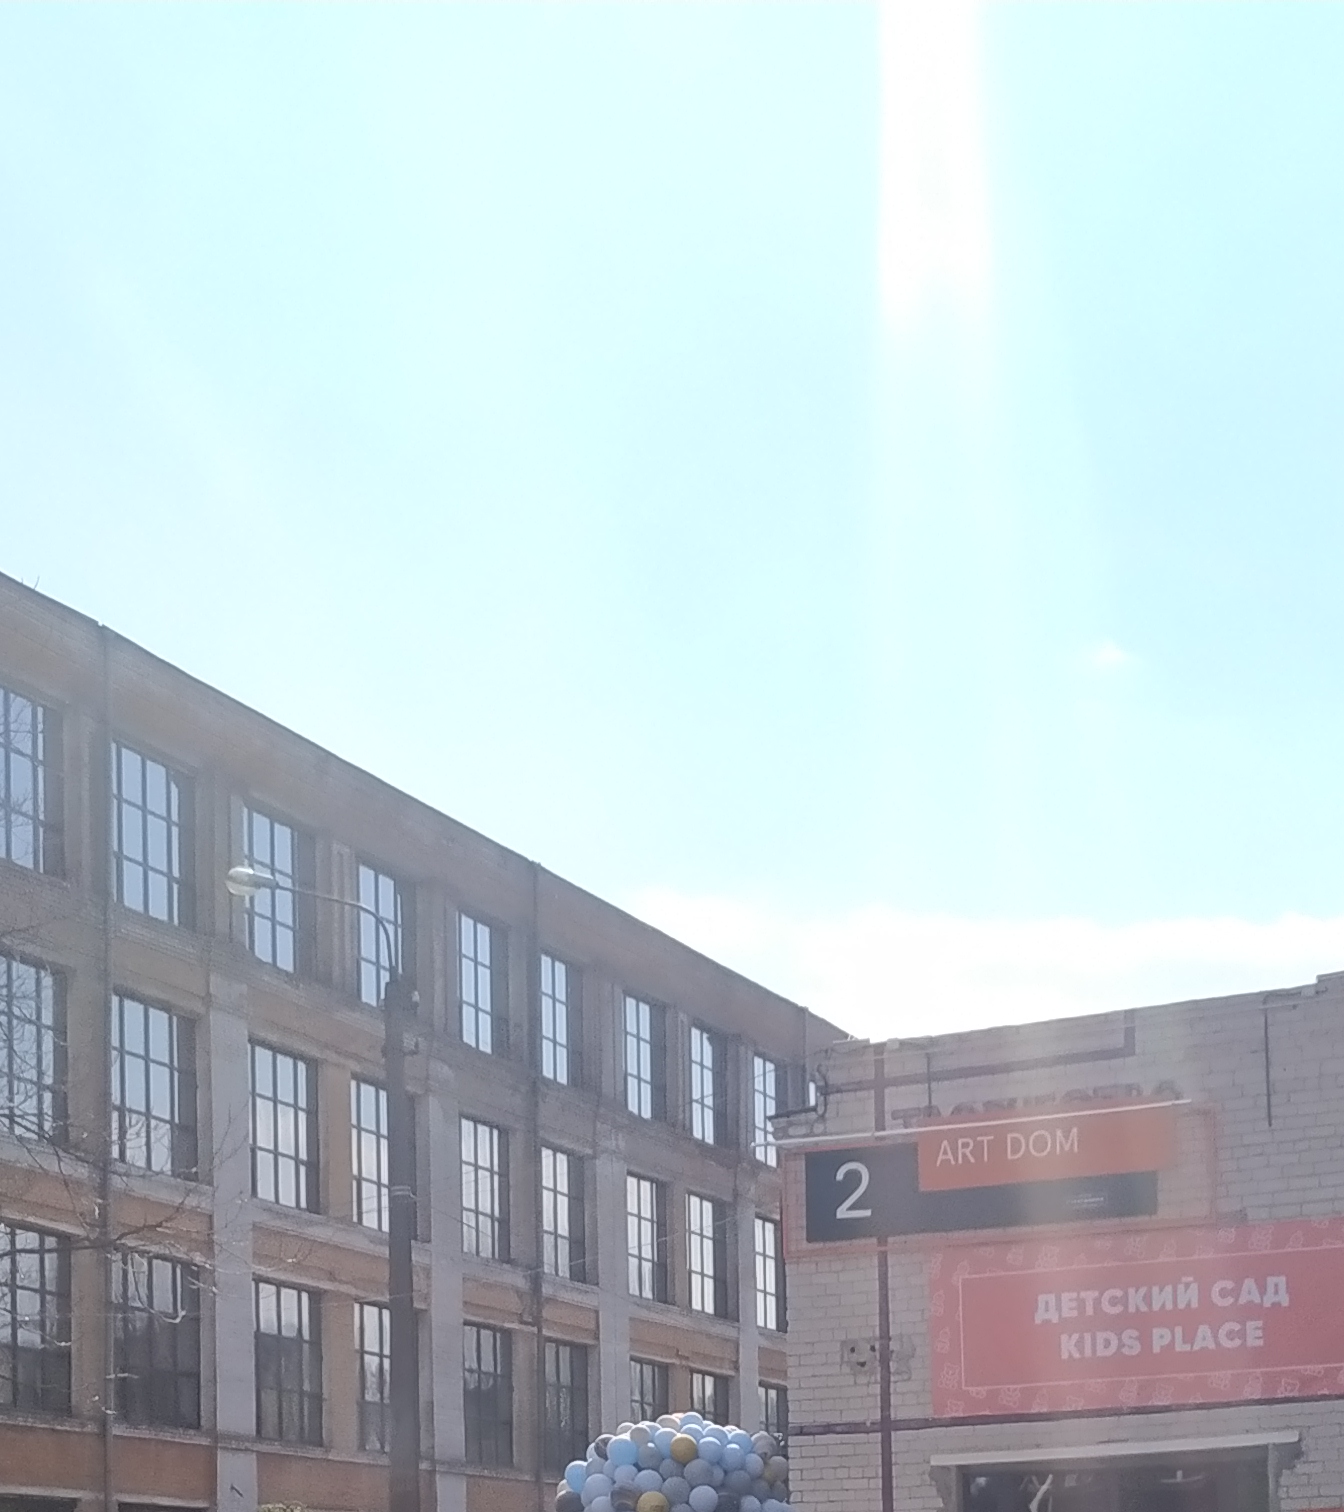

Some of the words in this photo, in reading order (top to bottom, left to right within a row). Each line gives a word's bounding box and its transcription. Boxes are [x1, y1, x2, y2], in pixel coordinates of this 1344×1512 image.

[835, 1161, 873, 1220] 2
[936, 1136, 994, 1167] ART
[1006, 1127, 1079, 1161] DOM
[1034, 1276, 1199, 1326] ДЕТСКИЙ
[1211, 1275, 1290, 1309] САД
[1059, 1327, 1142, 1360] KIDS
[1151, 1319, 1265, 1354] PLACE
